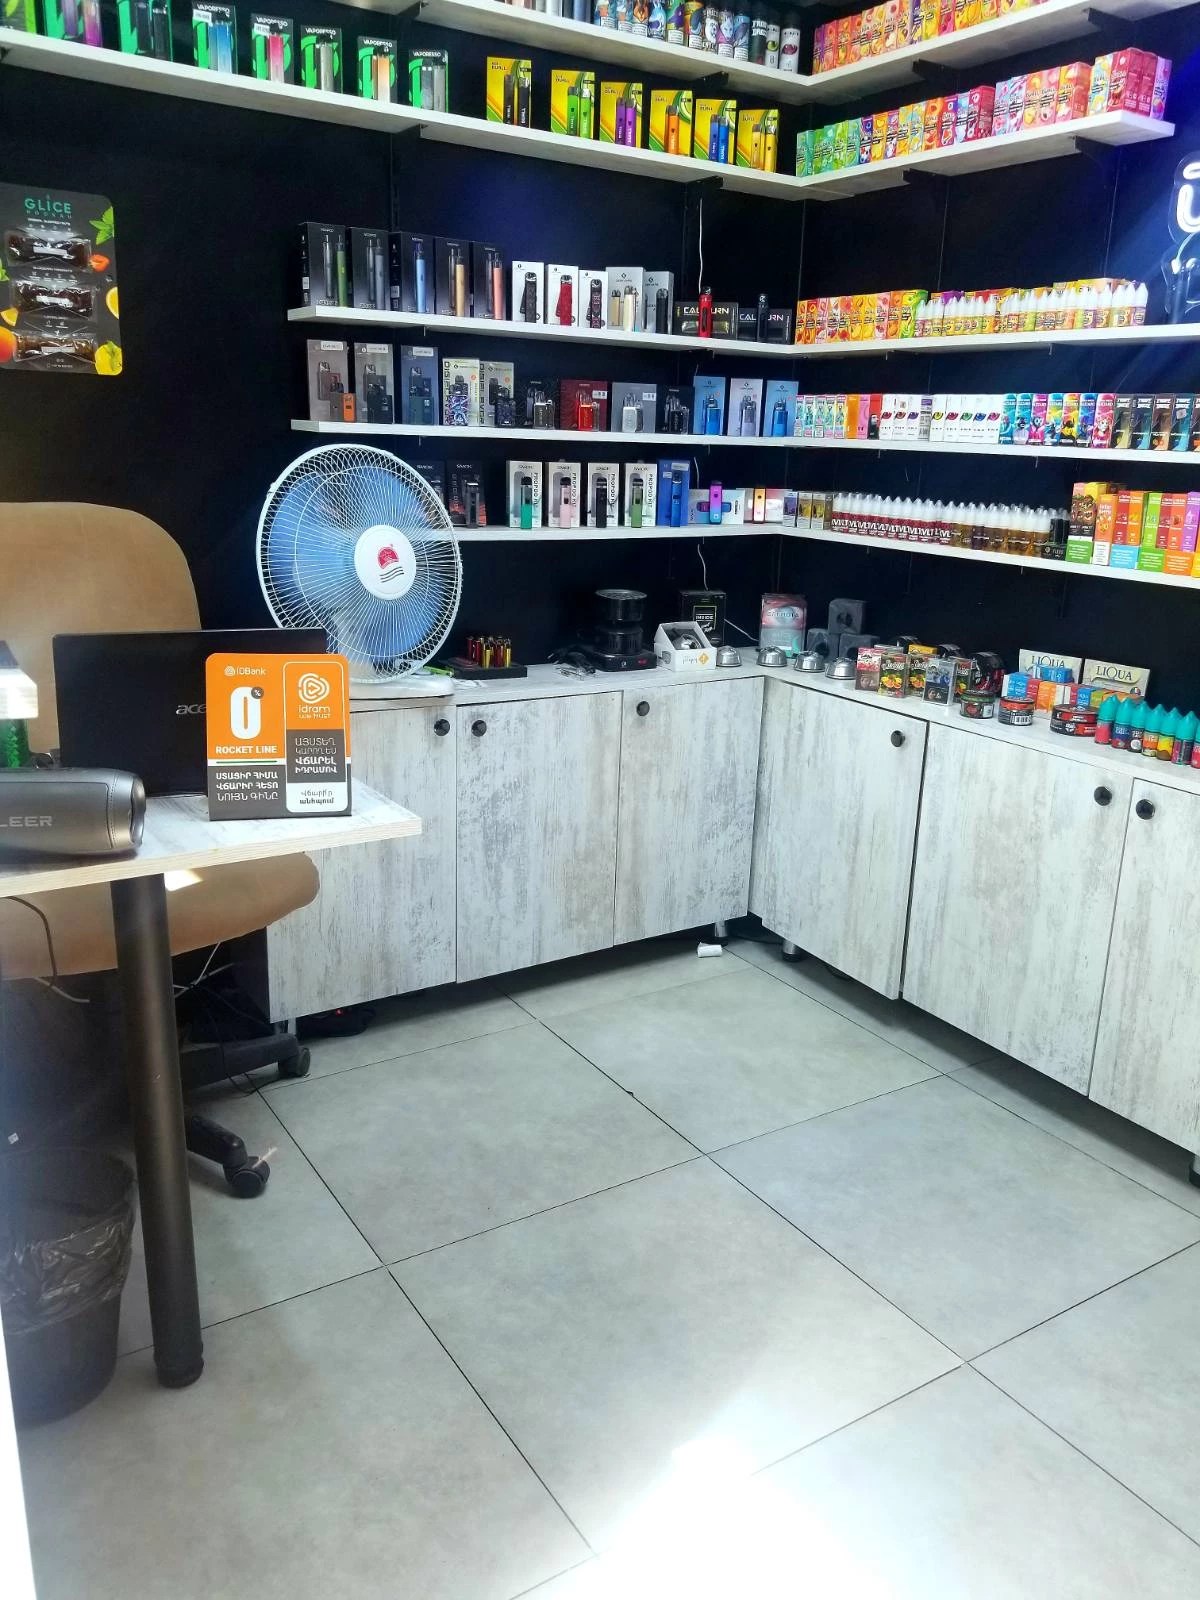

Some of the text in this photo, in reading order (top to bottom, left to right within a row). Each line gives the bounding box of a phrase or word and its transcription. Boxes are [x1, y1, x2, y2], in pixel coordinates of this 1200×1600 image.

[683, 307, 729, 317] CALURN
[1032, 656, 1065, 668] LIQUA
[1096, 666, 1132, 681] LIQUA
[176, 704, 207, 716] ace
[298, 705, 331, 713] idram
[295, 737, 336, 746] ԱՅՍՏԵՂ
[216, 745, 277, 754] ROCKET LINE
[295, 756, 337, 765] ՎՃԱՐԵԼ
[295, 766, 337, 774] ԻԴՐԱՄՈՎ
[216, 771, 278, 780] ՍՏԱՑԻՐ ՀԻՄԱ
[216, 781, 278, 790] ՎՃԱՐԻՐ ՀԵՏՈ
[217, 791, 278, 801] ՆՈՒՅՆ ԳԻՆԸ
